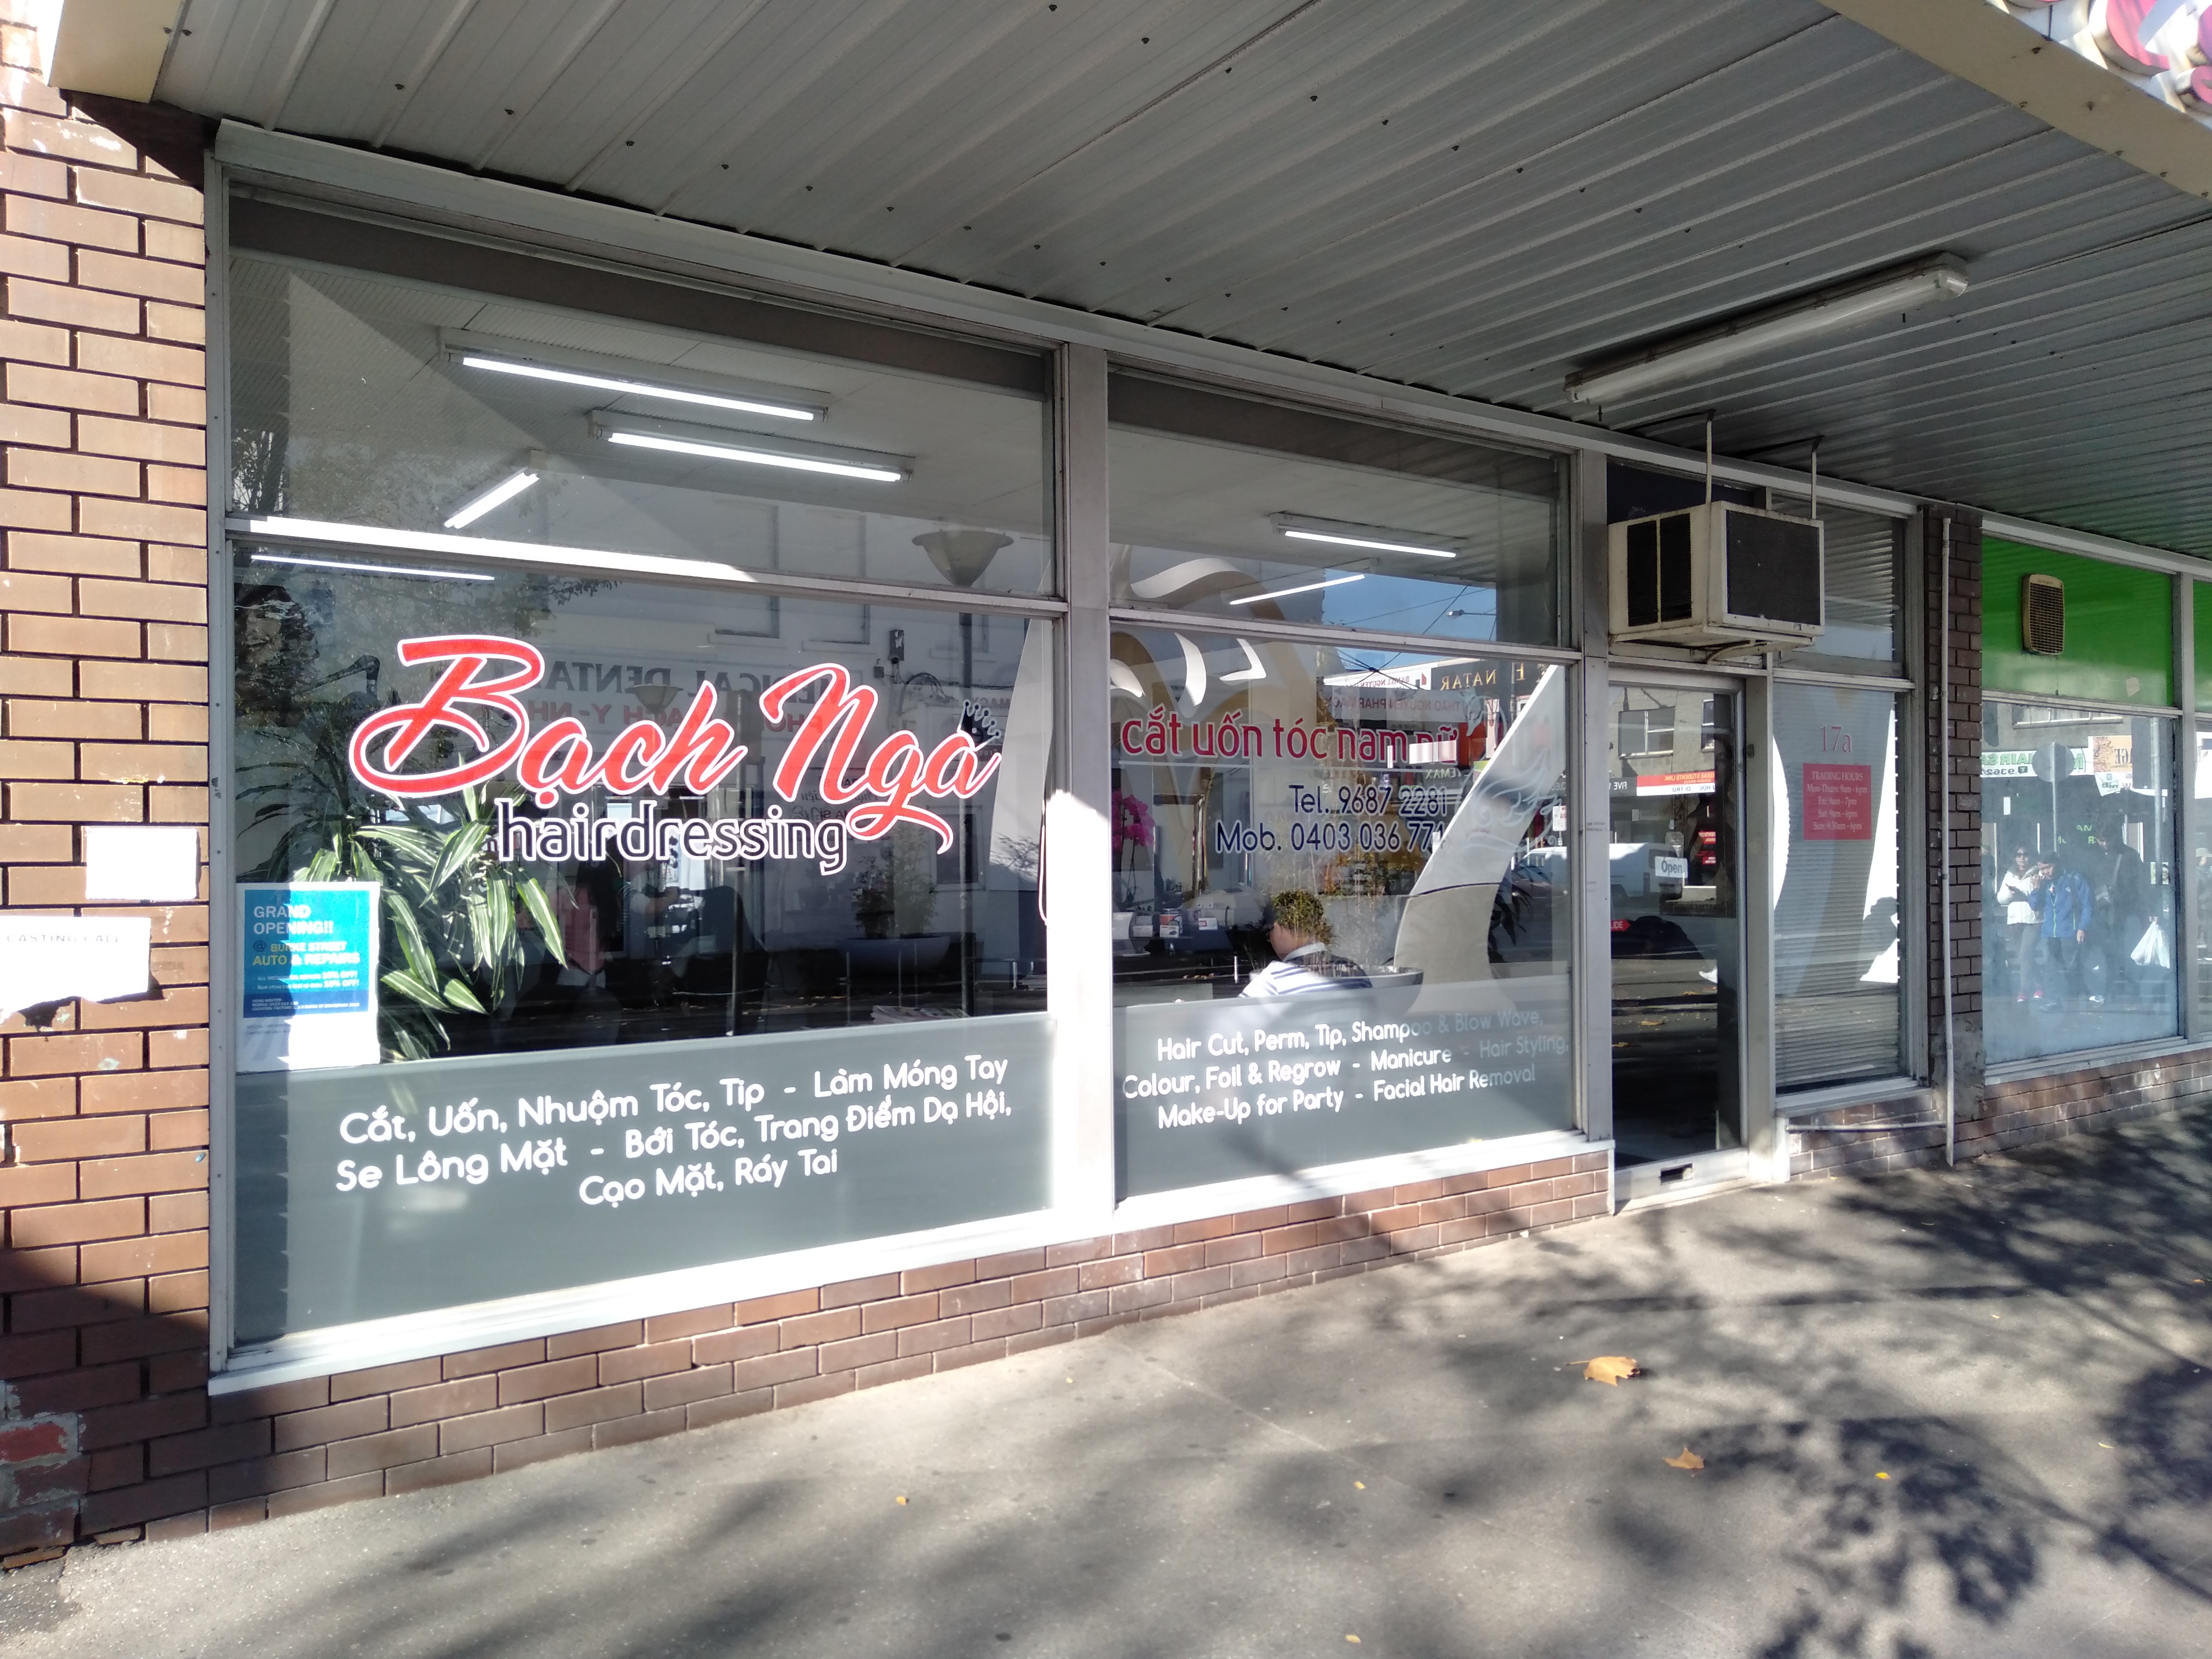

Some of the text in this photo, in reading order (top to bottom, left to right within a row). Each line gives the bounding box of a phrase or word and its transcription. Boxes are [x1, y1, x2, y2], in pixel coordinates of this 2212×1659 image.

[349, 635, 1002, 854] Bạch Nga
[1121, 703, 1182, 757] cắt
[1193, 709, 1262, 758] uốn
[1273, 717, 1328, 760] tóc
[1336, 727, 1409, 764] nam
[1821, 725, 1852, 752] 17a
[1812, 771, 1863, 781] TRADING HOURS
[1288, 784, 1447, 816] Tel. 9687 2281
[495, 799, 847, 876] hairdressing
[1216, 819, 1282, 853] Mob.
[1290, 822, 1352, 852] 0403
[1359, 822, 1402, 852] 036
[1661, 859, 1682, 876] Open
[253, 920, 334, 935] OPENING!!
[254, 904, 312, 918] GRAND
[253, 952, 361, 966] AUTO & REPAIRS
[270, 942, 307, 952] BURKE
[308, 941, 347, 952] STREET
[1157, 1008, 1544, 1062] Hair Cut, Perm, Tip, Shampoo & Blow Wave,
[1123, 1073, 1201, 1099] Colour,
[1205, 1064, 1242, 1091] Foil
[1248, 1062, 1263, 1085] &
[1268, 1058, 1341, 1084] Regrow
[1370, 1046, 1452, 1072] Manicure
[1479, 1039, 1511, 1060] Hair
[340, 1104, 416, 1144] Cắt,
[428, 1096, 508, 1137] Uốn,
[518, 1090, 638, 1127] Nhuộm
[650, 1082, 710, 1112] Tóc,
[719, 1078, 765, 1111] Tip
[814, 1068, 873, 1097] Làm
[883, 1059, 958, 1091] Móng
[964, 1054, 1008, 1085] Tay
[1158, 1101, 1252, 1129] Make-Up
[1258, 1094, 1288, 1117] for
[1293, 1087, 1344, 1112] Party
[1374, 1075, 1426, 1102] Facial
[1430, 1071, 1465, 1095] Hair
[1469, 1063, 1536, 1088] Removal
[336, 1159, 382, 1191] Se
[396, 1150, 489, 1185] Lông
[500, 1137, 568, 1176] Mặt
[684, 1120, 744, 1150] Tóc,
[754, 1114, 839, 1142] Trang
[846, 1094, 915, 1132] Điểm
[924, 1096, 958, 1125] Dạ
[966, 1088, 1011, 1120] Hội,
[579, 1149, 838, 1208] Cạo Mặt, Ráy Tai
